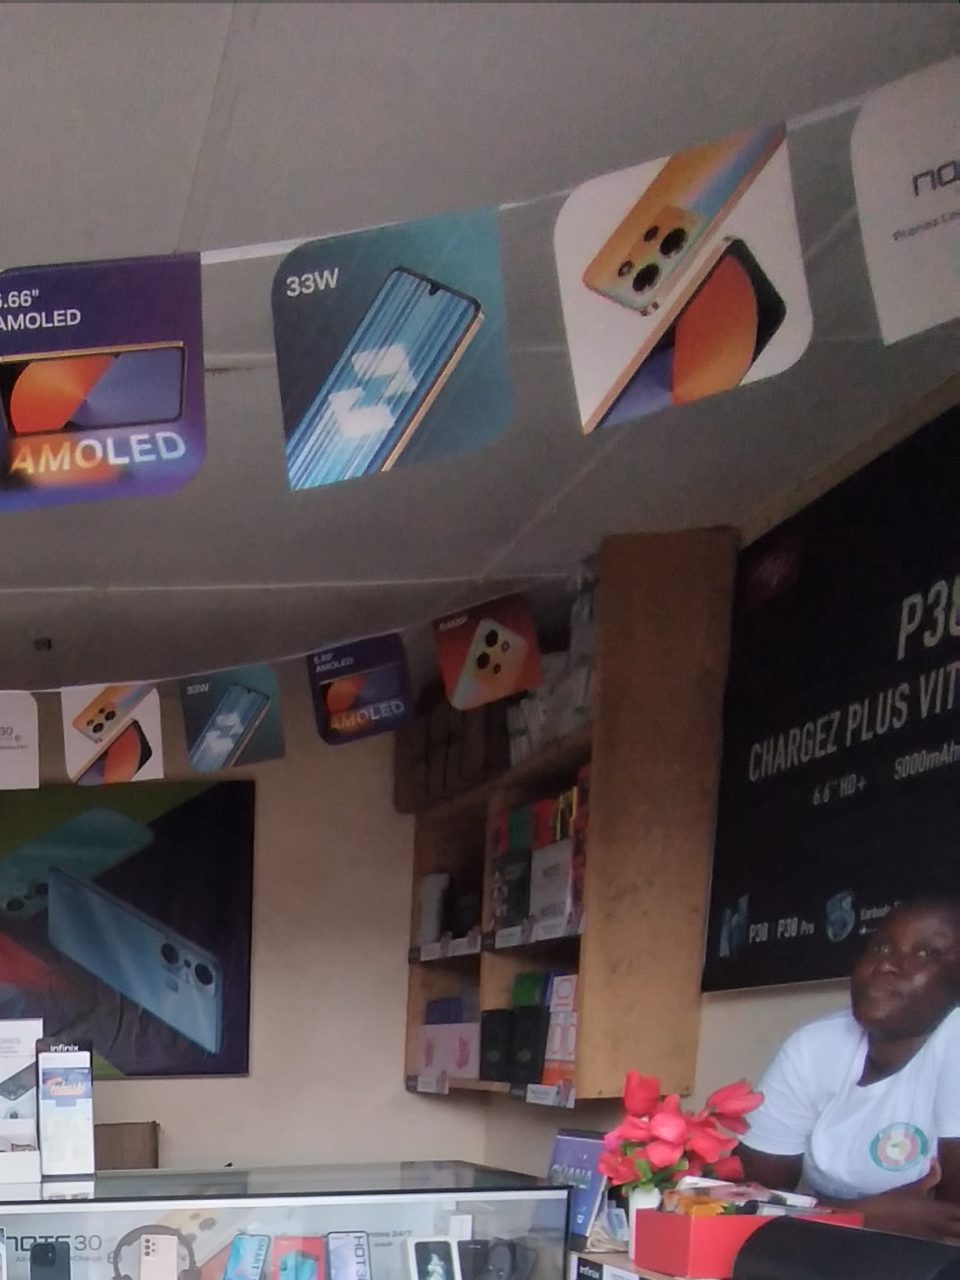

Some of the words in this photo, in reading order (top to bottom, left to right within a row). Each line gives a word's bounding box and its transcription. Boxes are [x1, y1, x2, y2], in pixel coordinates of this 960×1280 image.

[285, 267, 339, 297] 33W
[10, 430, 187, 476] AMOLED
[328, 699, 405, 732] AMOLED
[748, 711, 841, 783] CHARGEZ
[846, 682, 910, 747] PLUS
[75, 1235, 103, 1252] 30
